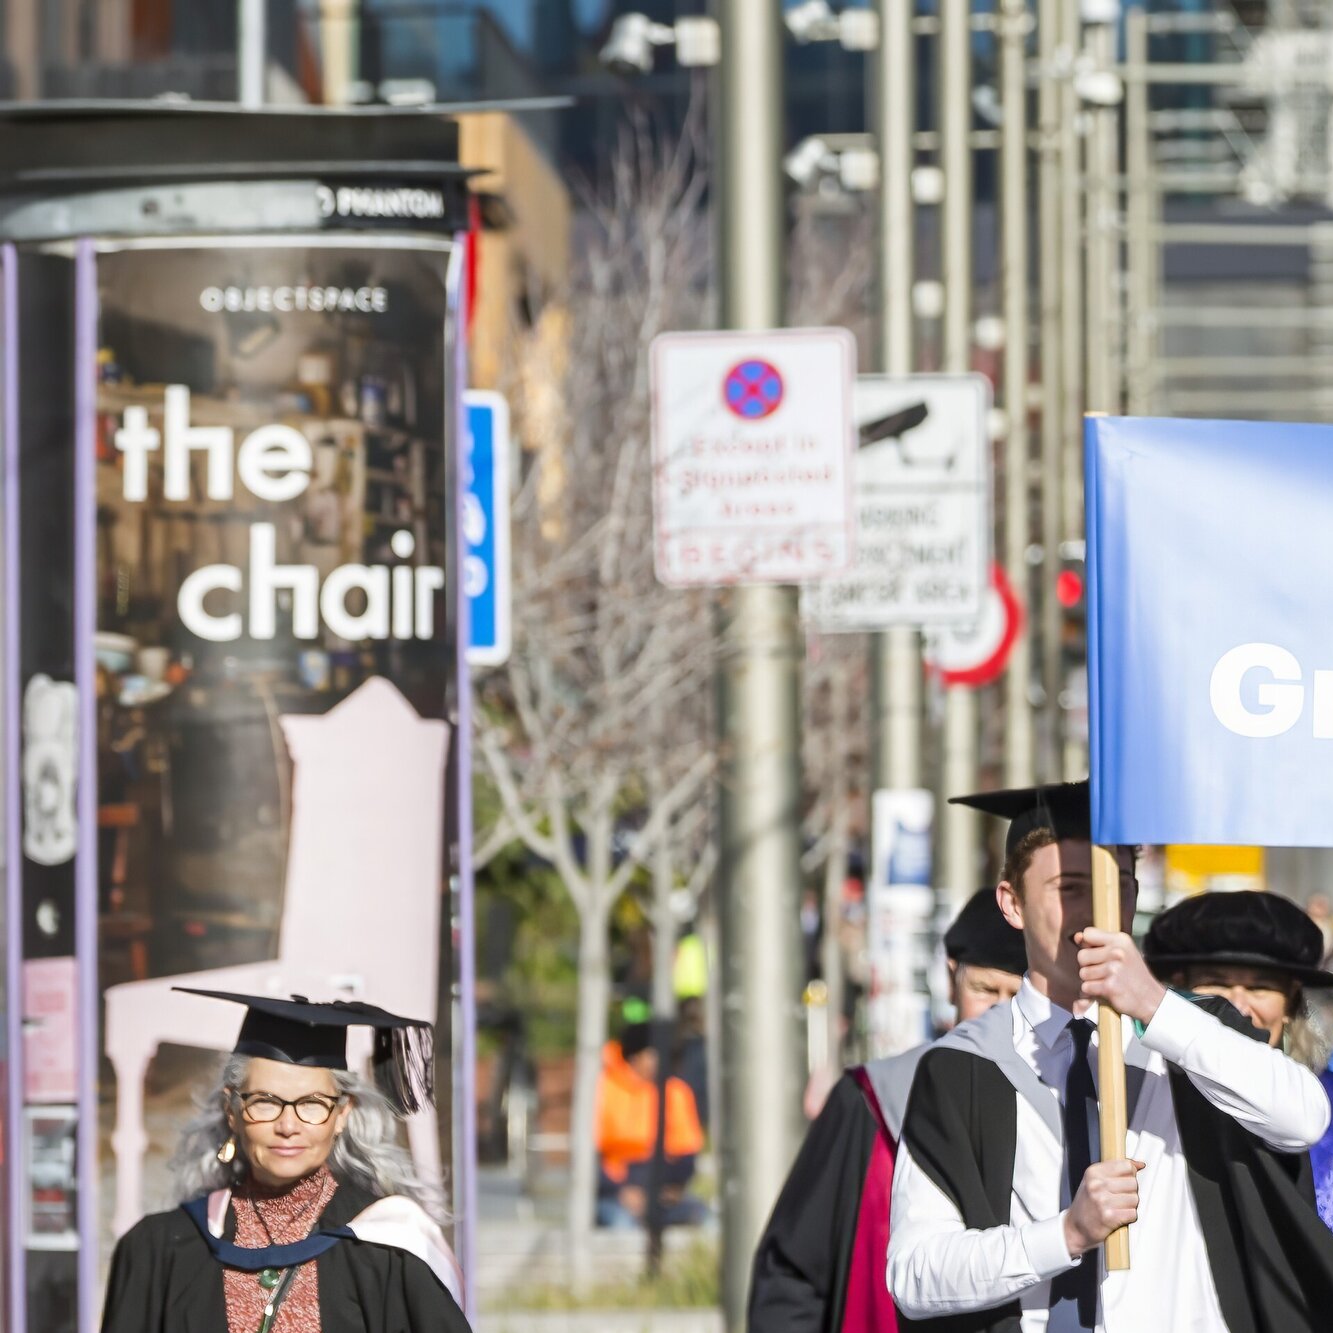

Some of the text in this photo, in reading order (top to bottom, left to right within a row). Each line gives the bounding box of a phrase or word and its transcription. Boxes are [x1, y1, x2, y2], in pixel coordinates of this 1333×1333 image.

[336, 187, 444, 218] PHANTOM
[200, 286, 388, 313] OBJECTSPACE
[114, 384, 313, 501] the
[177, 522, 443, 641] chair
